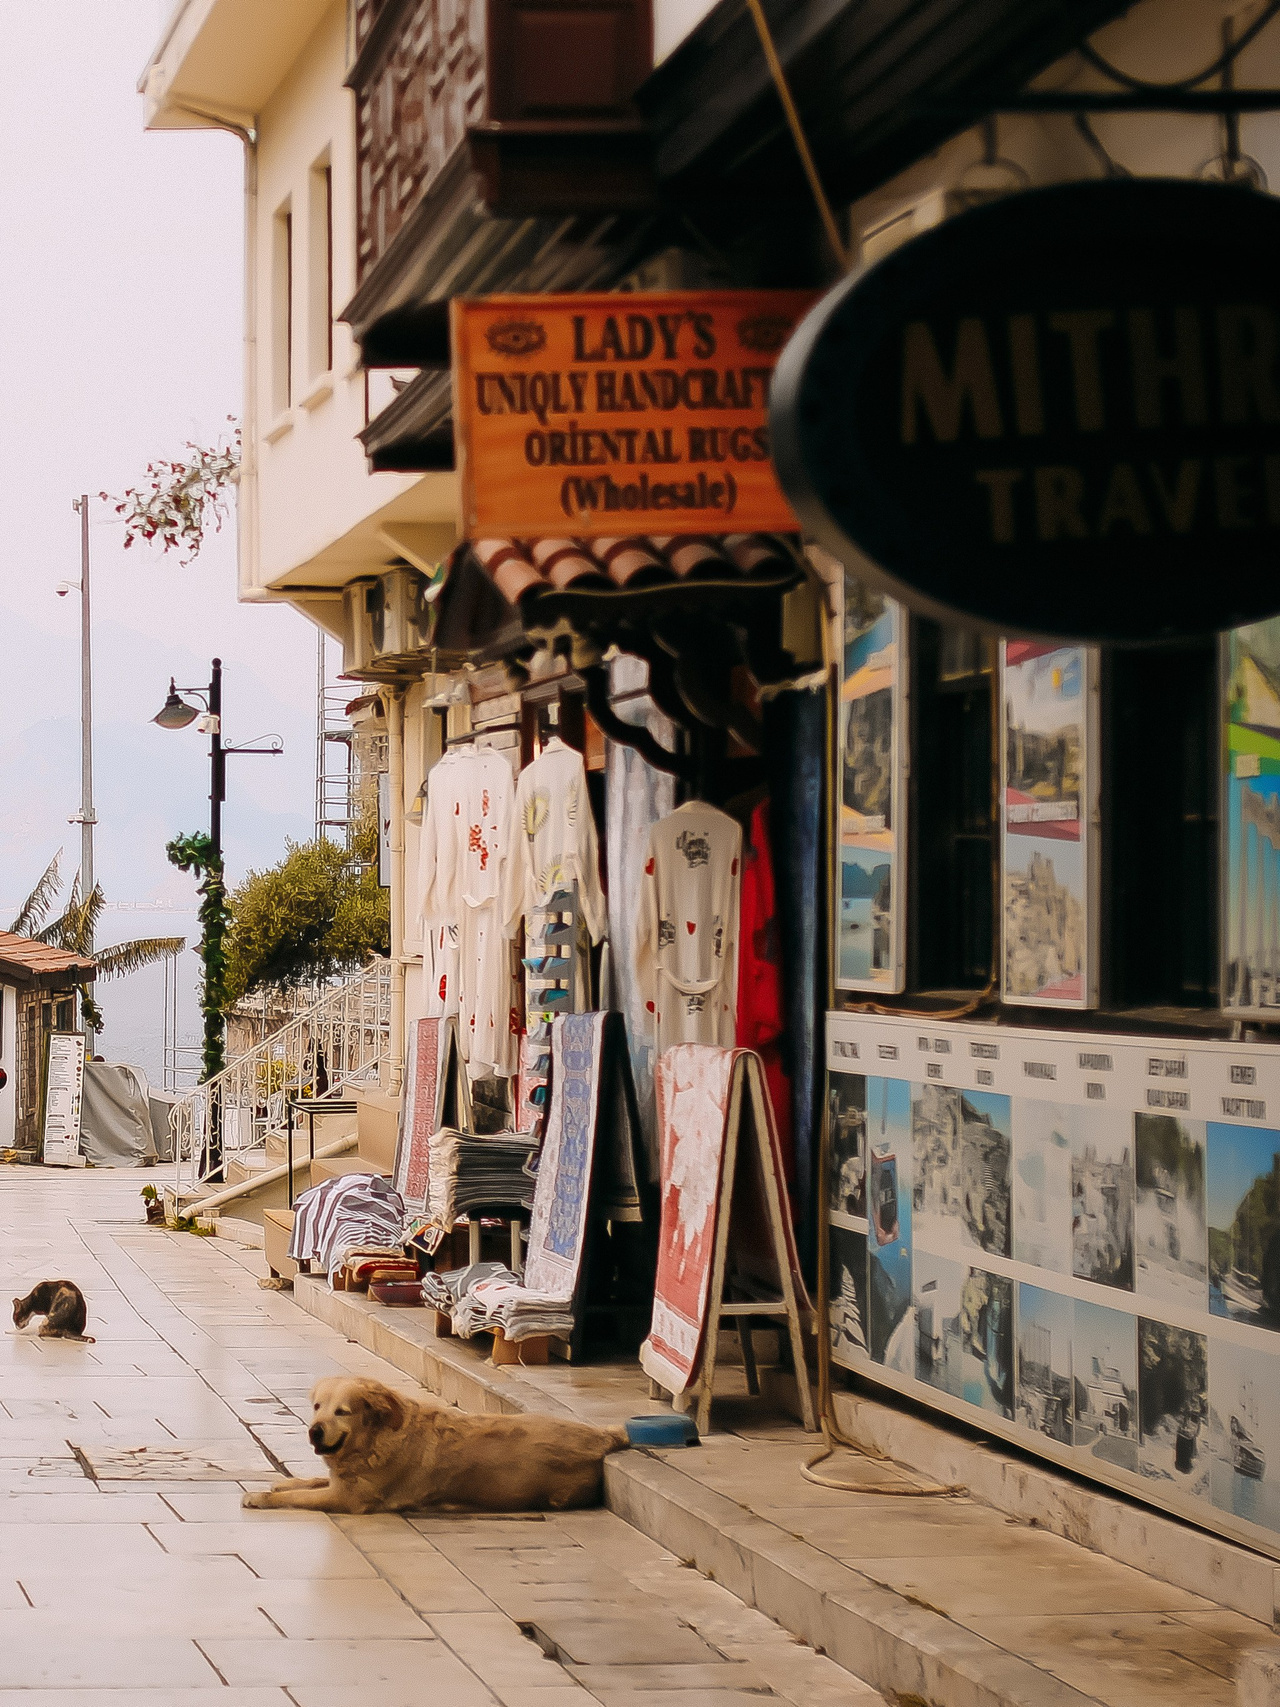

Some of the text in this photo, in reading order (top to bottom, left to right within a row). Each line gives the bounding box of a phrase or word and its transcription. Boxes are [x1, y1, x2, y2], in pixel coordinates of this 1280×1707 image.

[572, 310, 717, 363] LADY'S
[688, 426, 771, 462] RUGS
[561, 471, 737, 518] (Wholesale)
